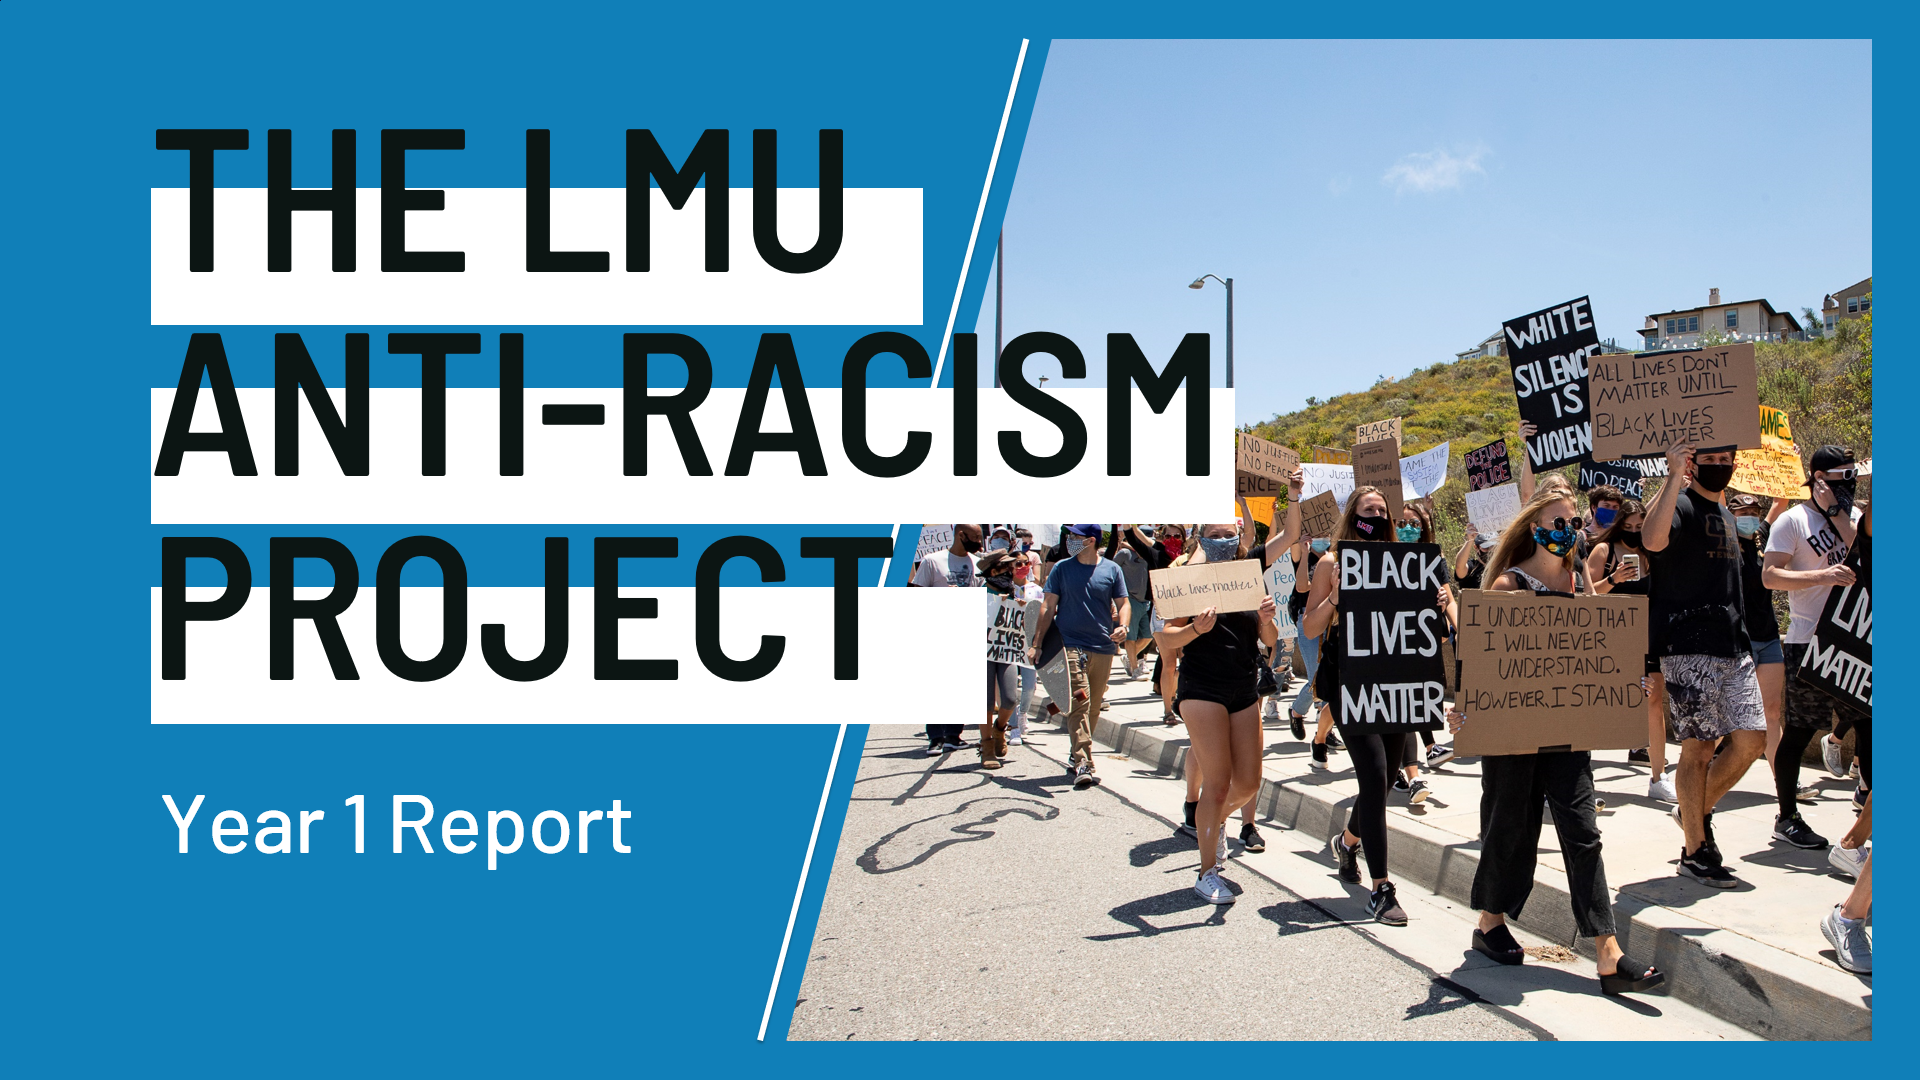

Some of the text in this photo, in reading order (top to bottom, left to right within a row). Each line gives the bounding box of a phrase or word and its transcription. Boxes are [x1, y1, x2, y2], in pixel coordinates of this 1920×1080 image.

[1505, 299, 1593, 350] WHITE
[1592, 363, 1624, 382] ALL
[1632, 358, 1676, 380] LIVES
[1551, 382, 1584, 419] IS
[1596, 372, 1738, 407] MATTER UNTIL
[1359, 420, 1396, 437] BLACK
[1595, 405, 1714, 438] BLACK LIVES
[1639, 425, 1716, 449] MATTER
[1243, 435, 1299, 467] NO JUSTICE
[1429, 447, 1447, 463] THE
[1465, 441, 1508, 469] DEFUND
[1244, 453, 1293, 479] NO PEACE
[1303, 467, 1325, 478] NO
[1469, 461, 1510, 492] POLICE
[1581, 467, 1608, 488] NO
[1310, 482, 1330, 494] NO
[1466, 484, 1517, 508] BLACK
[1473, 500, 1514, 520] LIVES
[1356, 520, 1374, 535] LMU
[1340, 548, 1442, 591] BLACK
[1154, 584, 1188, 600] black
[1188, 582, 1212, 594] lives
[1466, 604, 1639, 629] I UNDERSTAND THAT
[987, 627, 1026, 650] LIVES
[1346, 608, 1438, 658] LIVES
[1484, 630, 1608, 652] I WILL NEVER
[987, 645, 1026, 664] MATTER
[1498, 655, 1621, 680] UNDERSTAND.
[1341, 681, 1444, 725] MATTER
[1551, 686, 1567, 709] I
[1571, 682, 1644, 709] STAND
